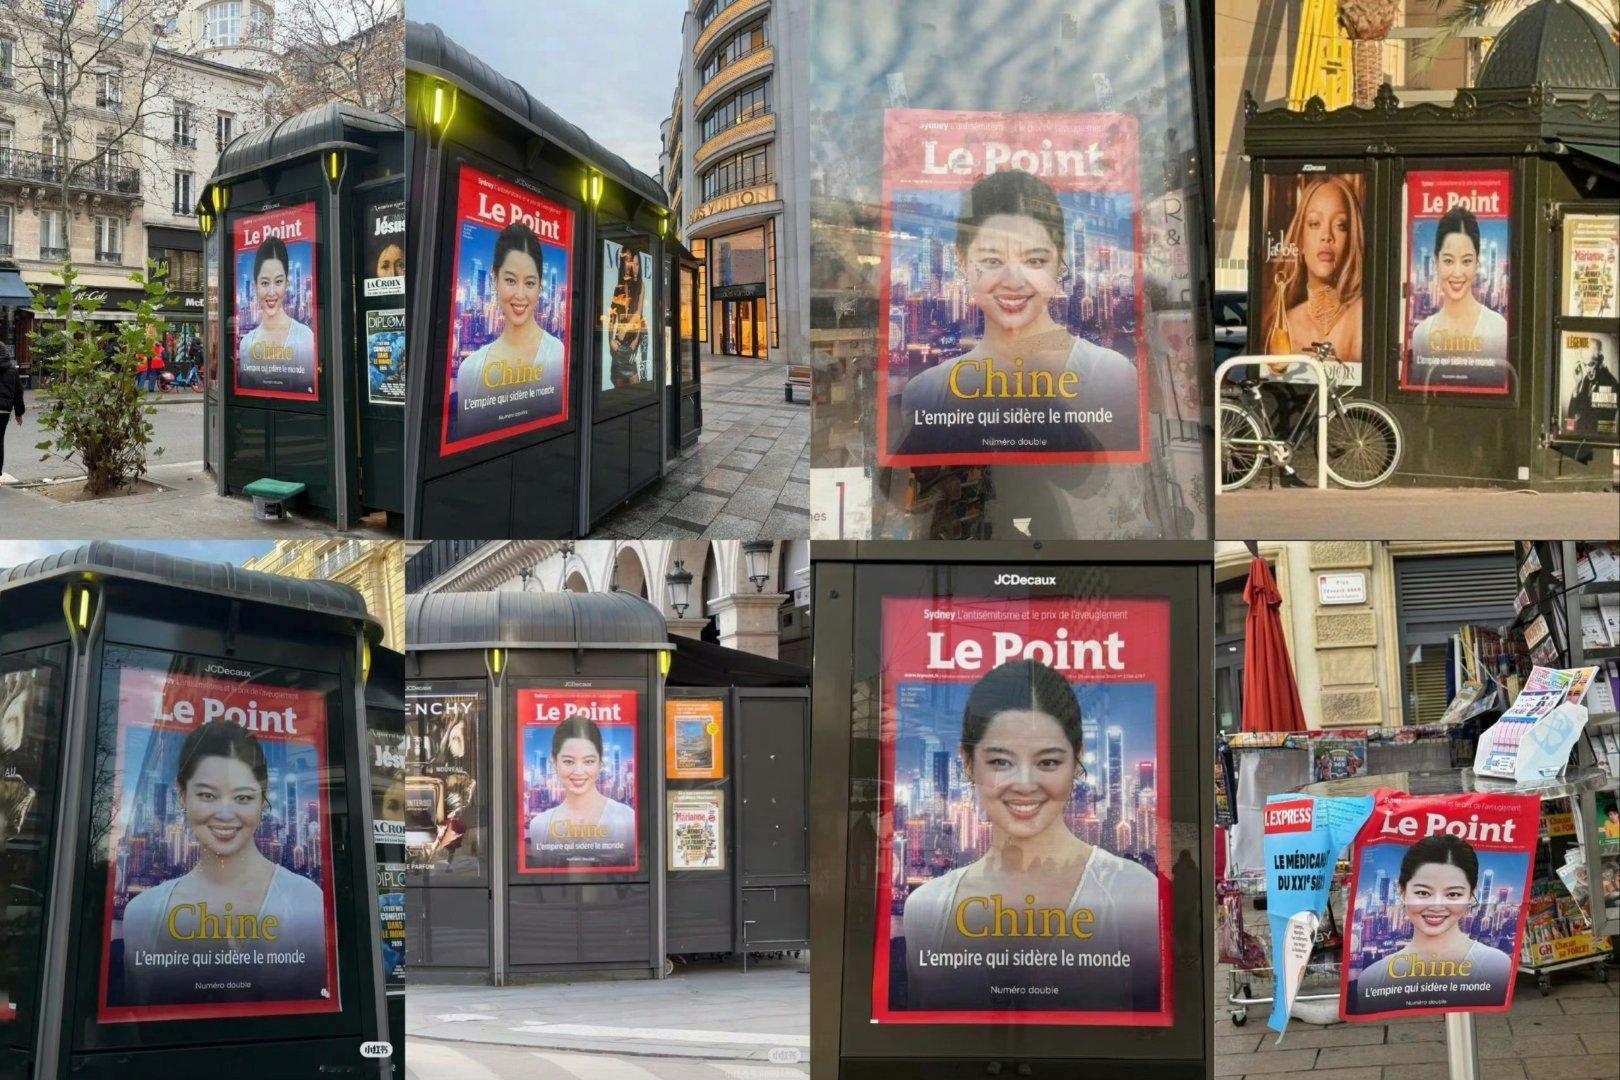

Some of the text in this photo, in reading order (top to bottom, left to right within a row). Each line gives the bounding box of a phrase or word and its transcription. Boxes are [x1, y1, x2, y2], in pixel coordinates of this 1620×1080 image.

[922, 138, 1105, 177] Le Point
[1422, 189, 1500, 213] Le Point
[478, 192, 506, 223] Le
[509, 202, 560, 241] Point
[243, 218, 302, 246] Le Point
[483, 358, 544, 389] Chine
[950, 356, 1080, 399] Chine
[464, 395, 497, 410] L'empire
[497, 391, 509, 407] qui
[509, 388, 529, 402] sidère
[529, 387, 536, 398] le
[914, 407, 1113, 427] L'empire qui sidère le monde
[981, 437, 1047, 446] Numéro double
[994, 574, 1057, 586] JCDecaux
[924, 609, 1128, 622] Sydney L'antisémitisme et le prix de l'aveuglement
[927, 627, 1125, 670] Le Point
[204, 664, 251, 678] JCDecaux
[152, 691, 298, 734] Le Point
[536, 701, 622, 721] Le Point
[1380, 810, 1419, 836] Le
[1424, 812, 1516, 843] Point
[564, 842, 574, 851] qui
[1274, 854, 1285, 869] LE
[1278, 875, 1289, 891] DU
[167, 902, 280, 942] Chine
[955, 894, 1096, 940] Chine
[135, 949, 306, 968] L'empire qui sidère le monde
[919, 949, 1131, 969] L'empire qui sidère le monde
[1539, 944, 1553, 956] GH
[1387, 952, 1473, 979] Chine
[195, 981, 252, 990] Numéro double
[990, 985, 1059, 995] Numéro double
[1365, 981, 1491, 998] L'empire qui sidère le monde
